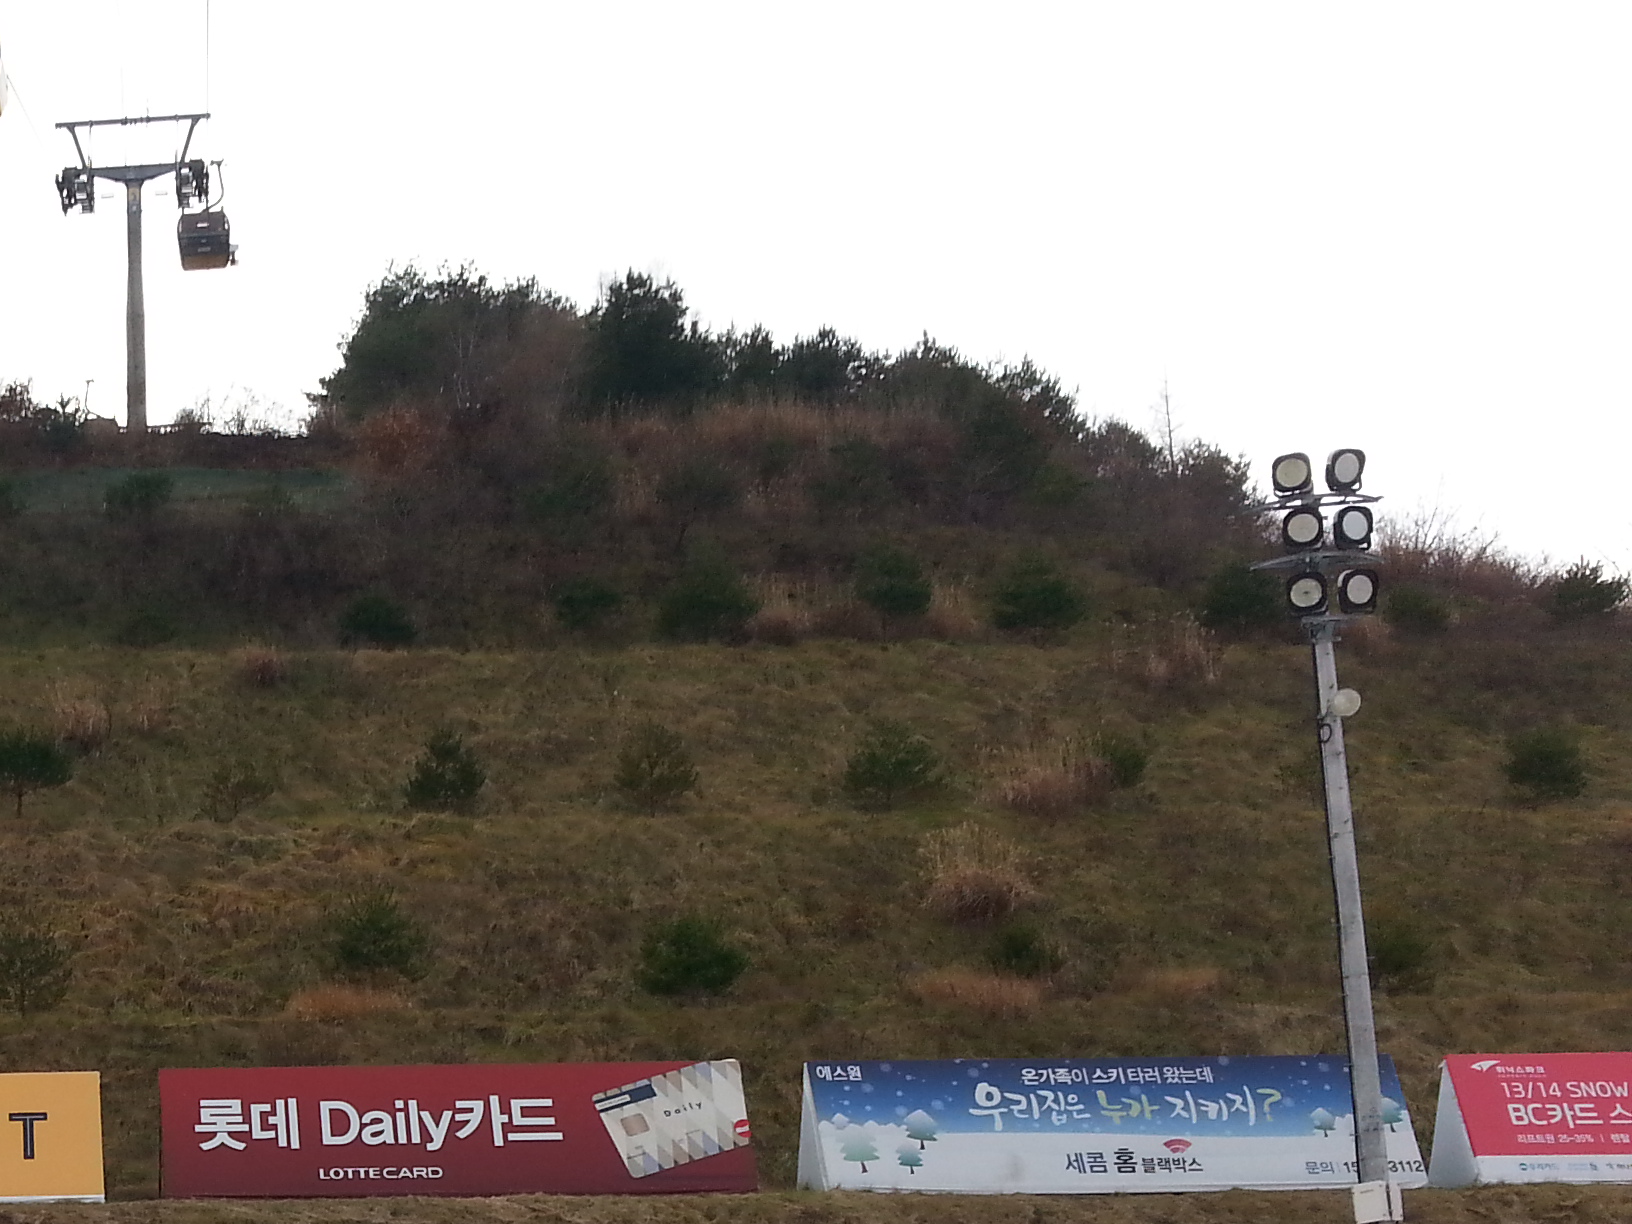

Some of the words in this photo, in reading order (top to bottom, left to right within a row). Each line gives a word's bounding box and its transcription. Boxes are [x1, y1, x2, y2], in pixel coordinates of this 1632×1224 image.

[816, 1065, 863, 1081] 에스원
[1021, 1068, 1090, 1085] 온가족이
[1092, 1067, 1126, 1084] 스키
[1127, 1067, 1161, 1084] 타러
[1163, 1066, 1214, 1084] 왔는데
[1501, 1082, 1562, 1098] 13/14
[1567, 1082, 1629, 1098] SNOW
[664, 1101, 703, 1118] Daily
[969, 1082, 1091, 1131] 우리집은
[1096, 1089, 1160, 1125] 누가
[1164, 1085, 1282, 1126] 지키지?
[1507, 1102, 1604, 1128] BC카드
[194, 1097, 301, 1151] 롯데
[319, 1095, 564, 1151] Daily카드
[1066, 1152, 1108, 1174] 세콤
[1113, 1148, 1138, 1174] 홈
[1141, 1157, 1204, 1173] 블랙박스
[1305, 1161, 1335, 1174] 문의
